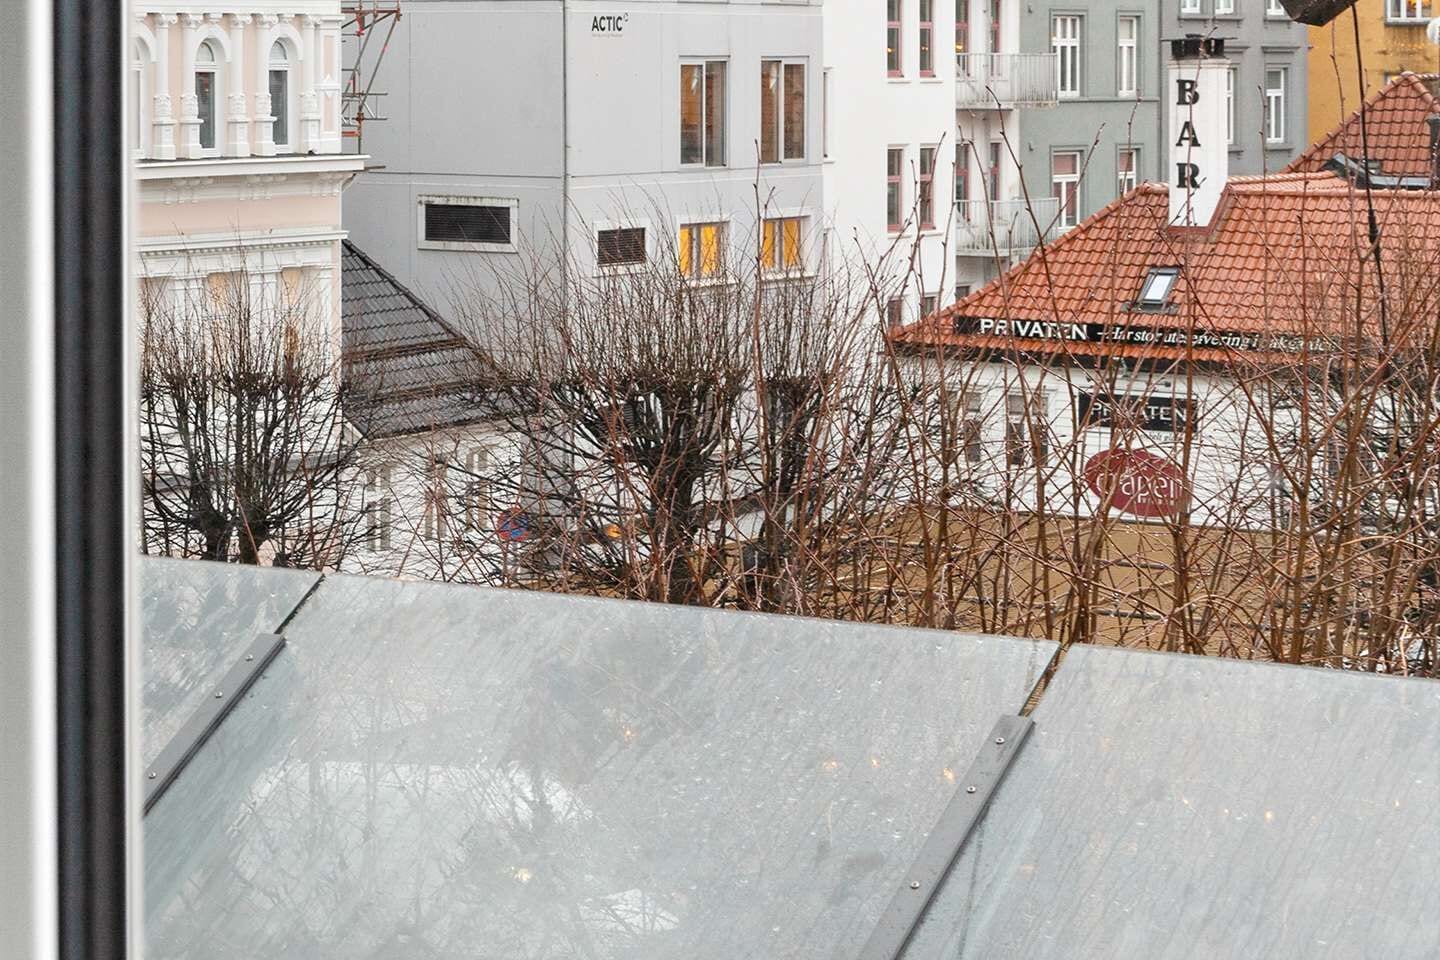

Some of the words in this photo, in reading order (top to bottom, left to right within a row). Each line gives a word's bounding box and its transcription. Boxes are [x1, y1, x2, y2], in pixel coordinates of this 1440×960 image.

[591, 15, 624, 32] ACTIC
[1175, 79, 1201, 189] BAR
[980, 318, 1088, 340] PRIVATEN
